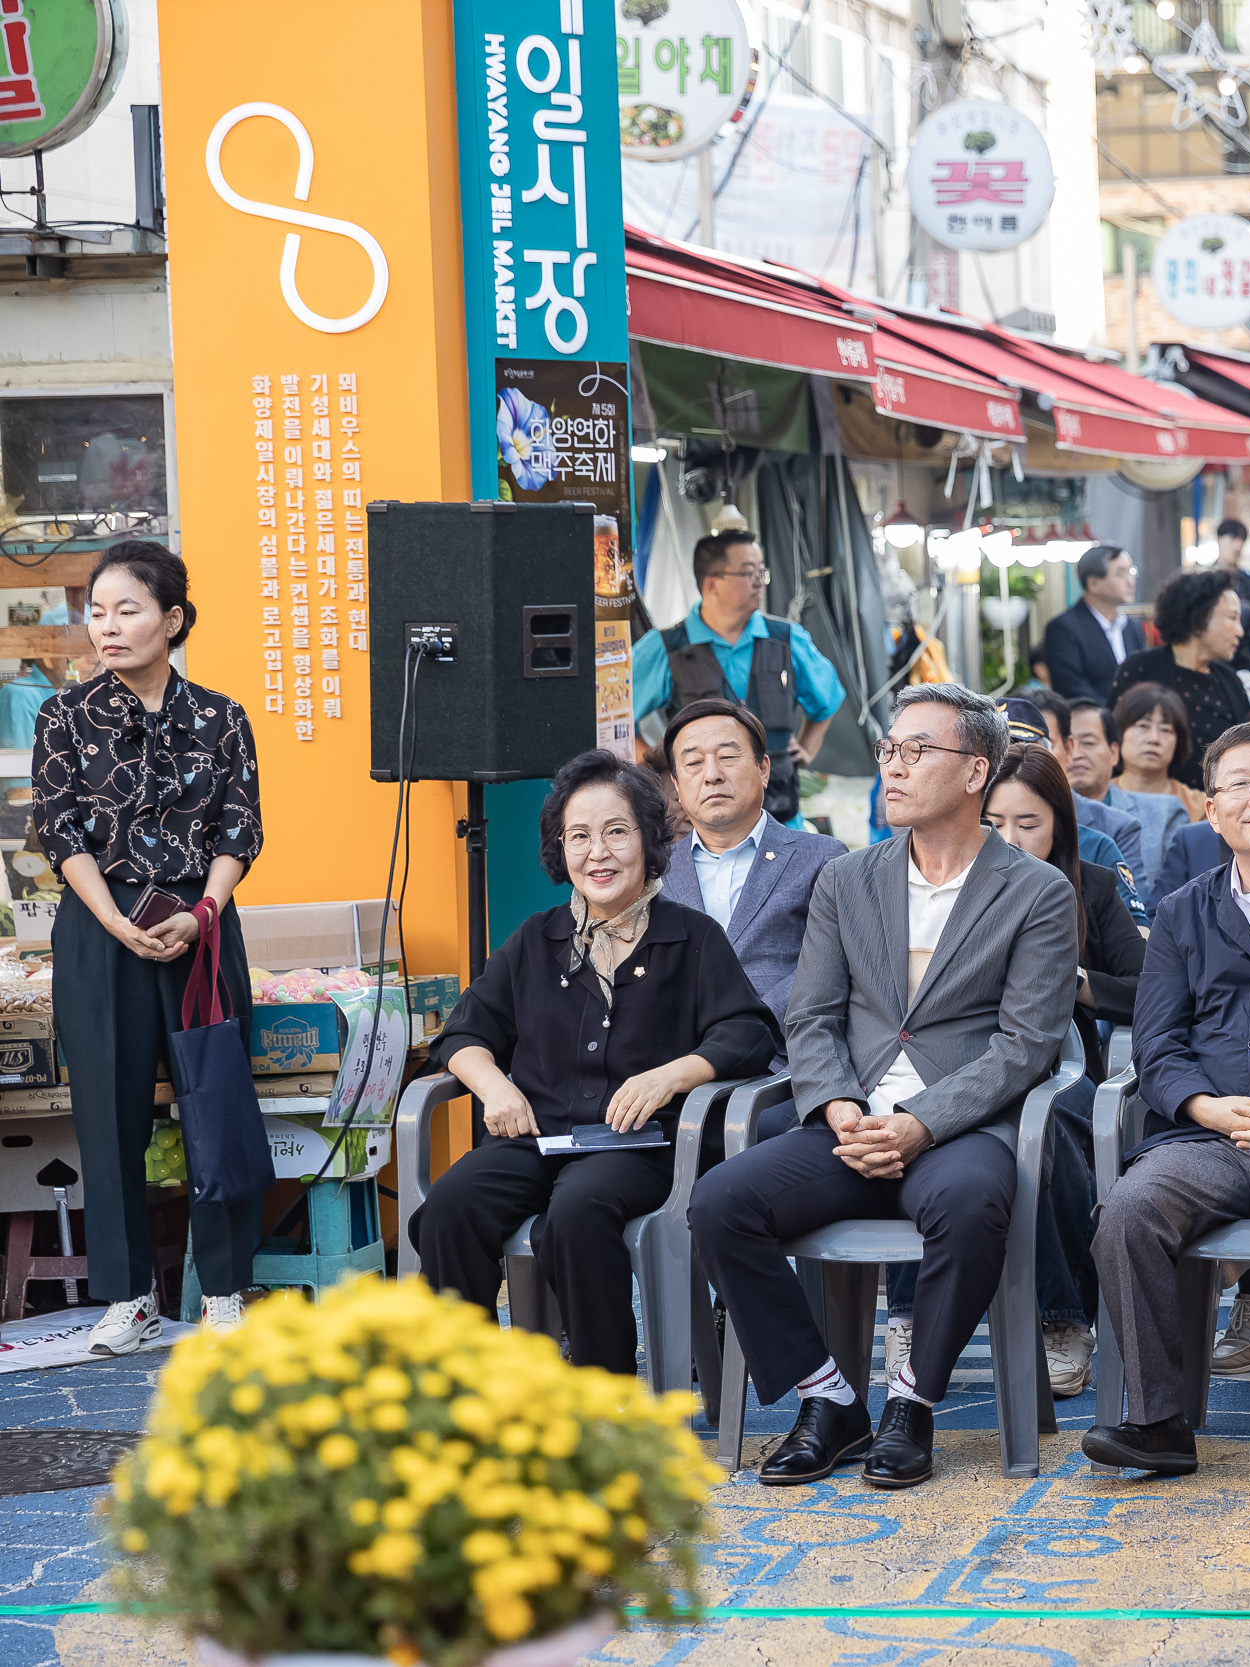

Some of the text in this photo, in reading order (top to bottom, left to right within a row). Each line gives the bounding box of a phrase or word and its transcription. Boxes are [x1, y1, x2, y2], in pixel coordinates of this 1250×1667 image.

[484, 32, 518, 350] HWAYANG JEIL MARKET
[516, 0, 597, 355] 일시장
[931, 161, 1029, 205] 꽃
[338, 373, 368, 652] 뫼비우스의 띠는 전통과 현대
[530, 417, 616, 448] 화양연화
[530, 451, 616, 482] 맥주축제
[582, 486, 616, 497] FESTIVAL
[252, 374, 285, 714] 화양제일시장의 심볼과 로고입니다
[280, 374, 314, 741] 발전을 이뤄나간다는 컨셉을 형상화한
[310, 373, 342, 719] 기성세대와 젊은세대가 조화를 이뤄
[262, 1028, 319, 1048] manna
[269, 1141, 305, 1157] 샤인
